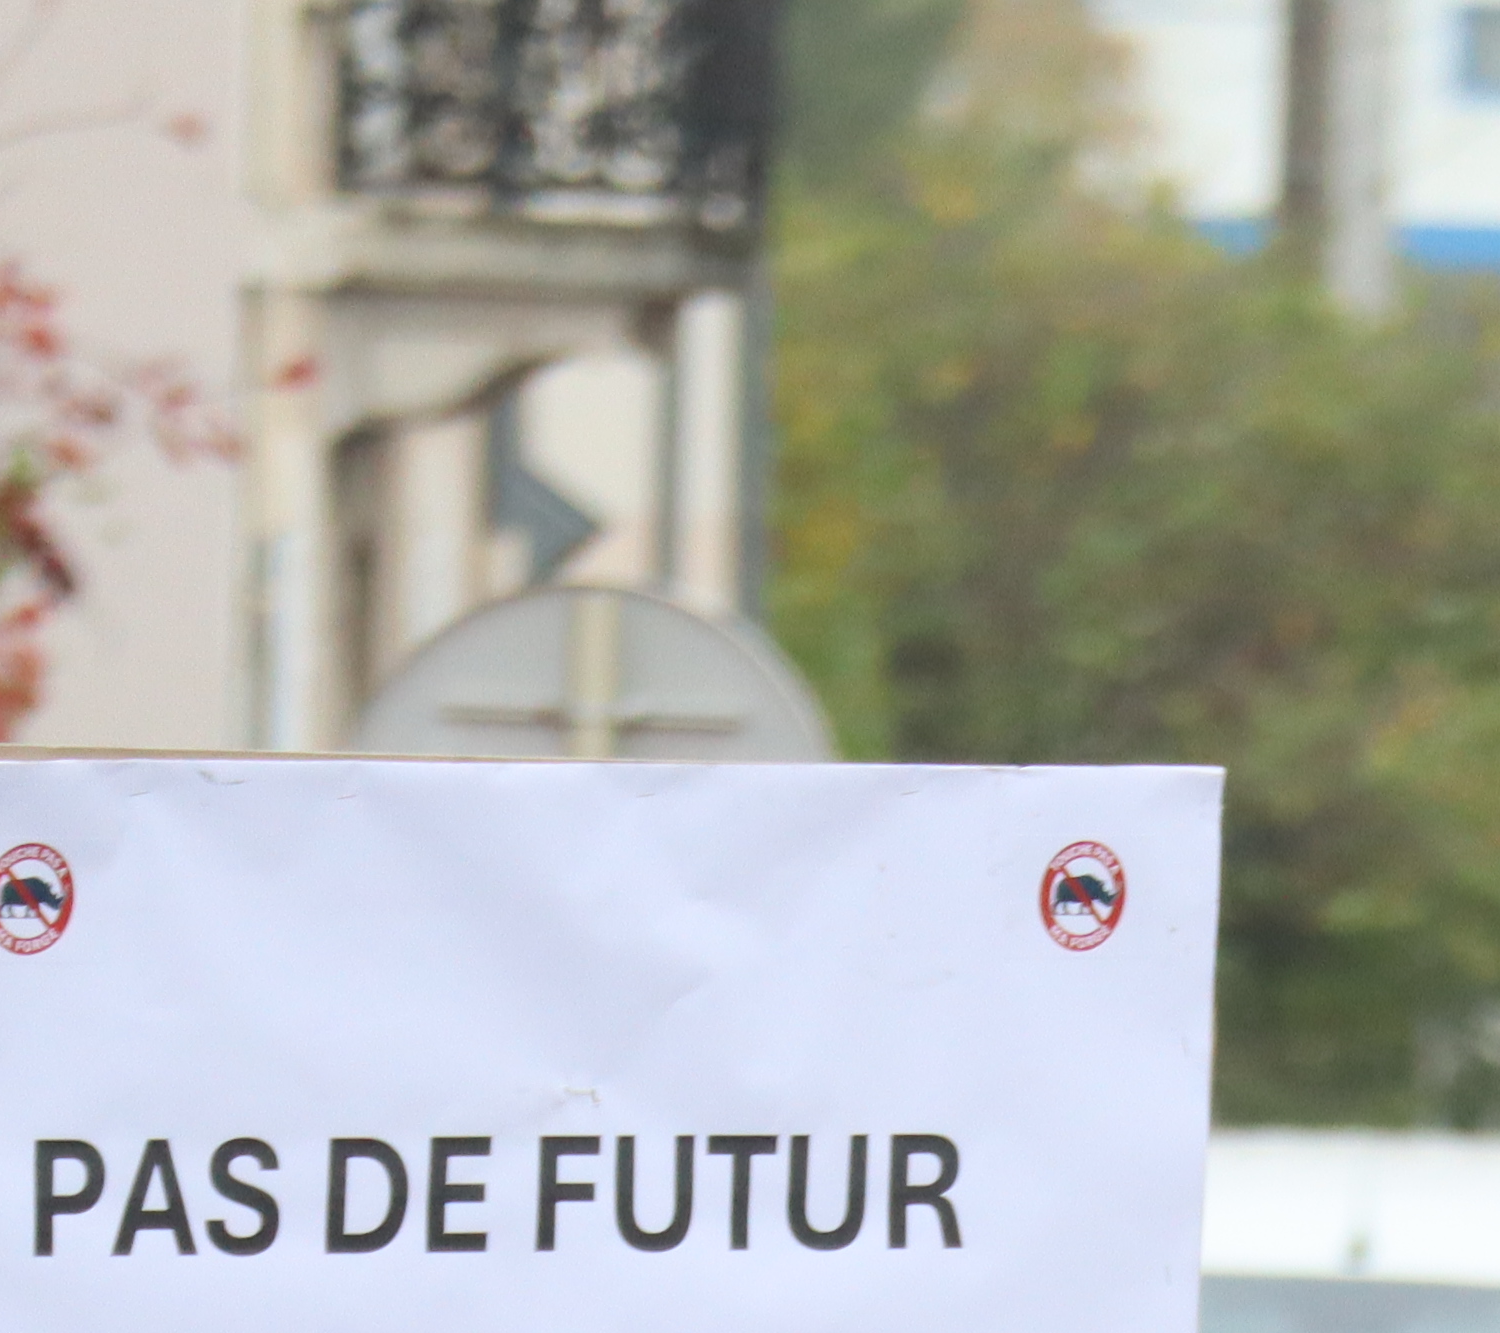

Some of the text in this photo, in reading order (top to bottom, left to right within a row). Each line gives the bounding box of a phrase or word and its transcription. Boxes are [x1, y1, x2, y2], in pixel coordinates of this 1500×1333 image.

[33, 1134, 963, 1256] PAS DE FUTUR
